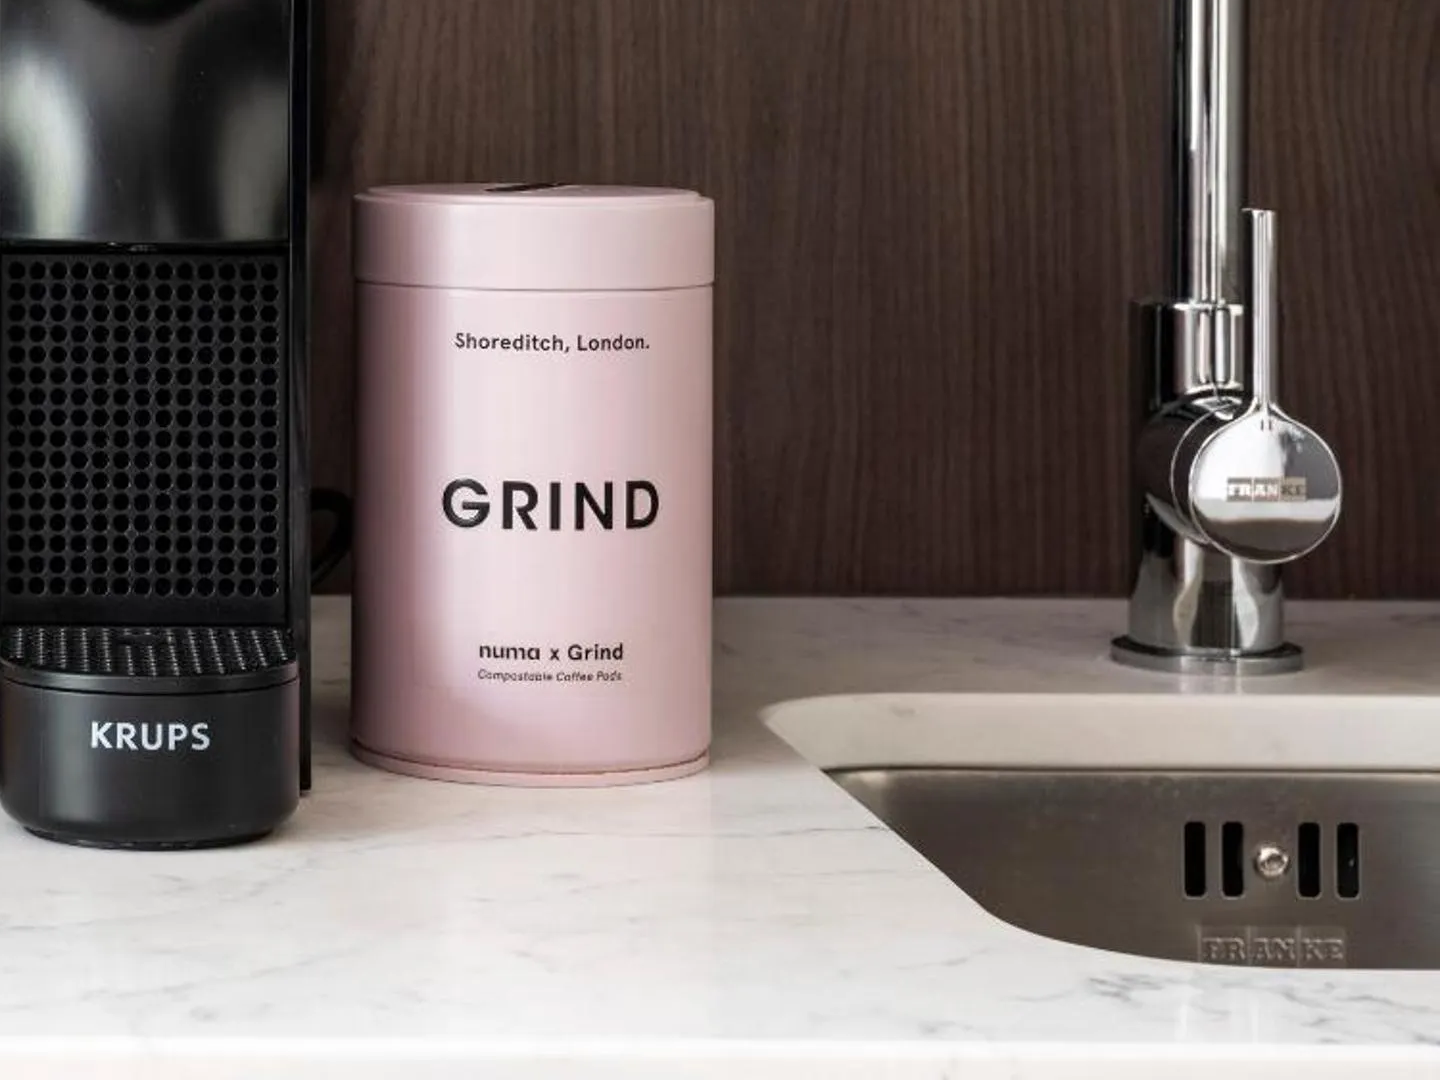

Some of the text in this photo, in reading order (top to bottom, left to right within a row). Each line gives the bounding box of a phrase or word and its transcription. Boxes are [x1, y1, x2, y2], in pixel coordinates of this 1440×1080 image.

[455, 332, 651, 353] Shoreditch, London.
[1228, 482, 1306, 497] FRANKE
[441, 478, 660, 531] GRIND
[479, 643, 624, 661] numa x Grind
[556, 670, 594, 682] Coffee
[597, 671, 622, 682] Pods
[90, 721, 211, 750] KRUPS
[1201, 937, 1344, 961] FRANKE
